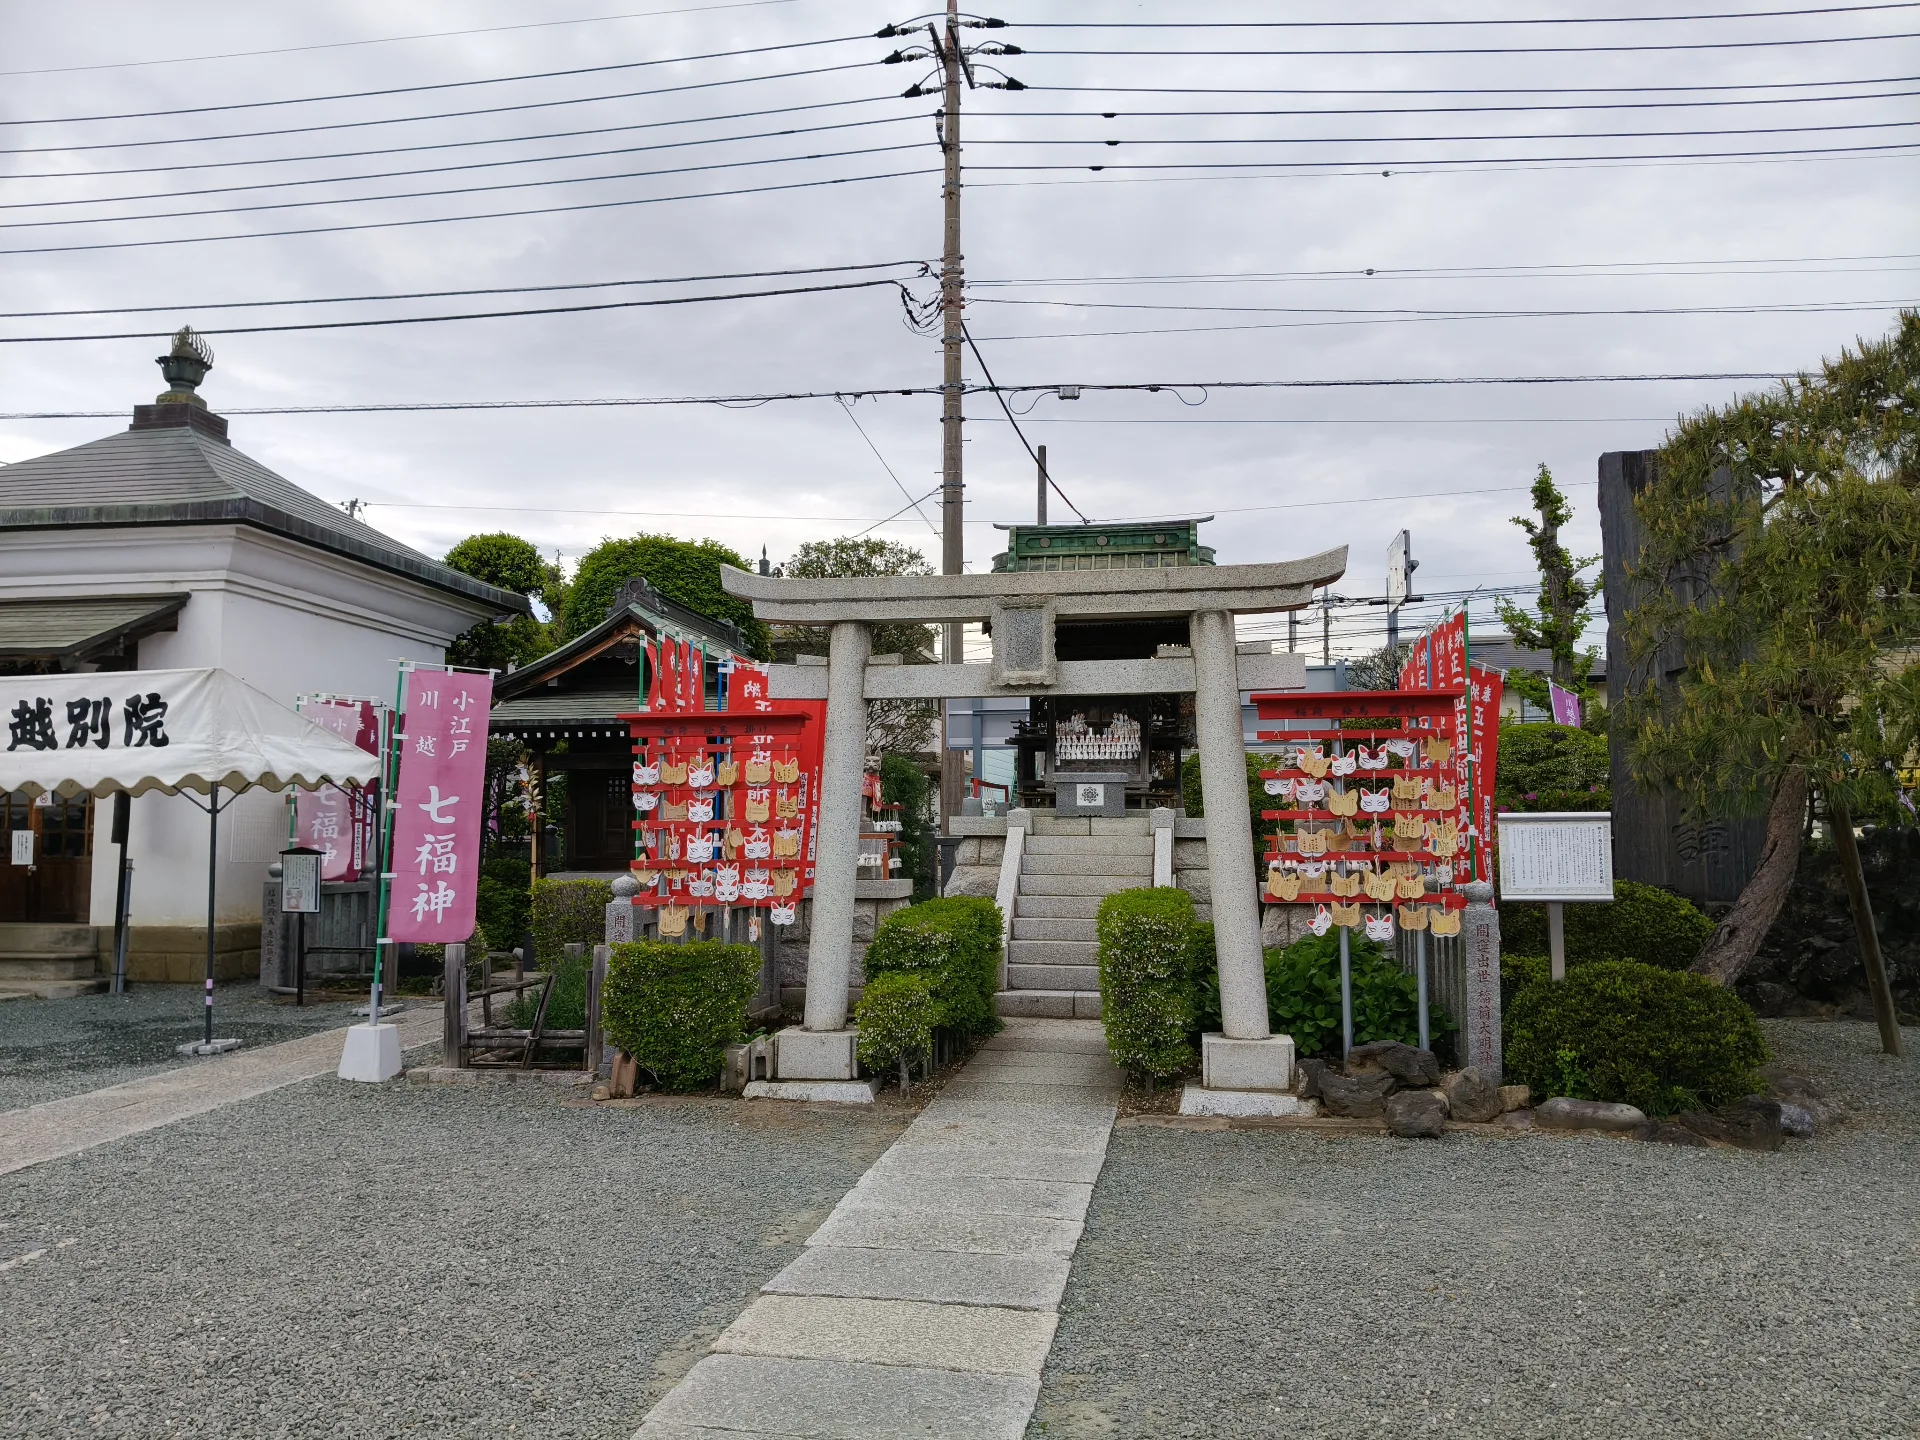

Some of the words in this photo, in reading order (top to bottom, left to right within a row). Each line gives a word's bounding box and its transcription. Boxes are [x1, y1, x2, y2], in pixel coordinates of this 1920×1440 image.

[7, 692, 169, 751] 越別院
[415, 690, 439, 757] 川越
[448, 690, 475, 760] 小江戸
[409, 785, 460, 924] 七福神
[1474, 923, 1491, 984] 開運出世
[1477, 989, 1493, 1068] 稲荷大明神
